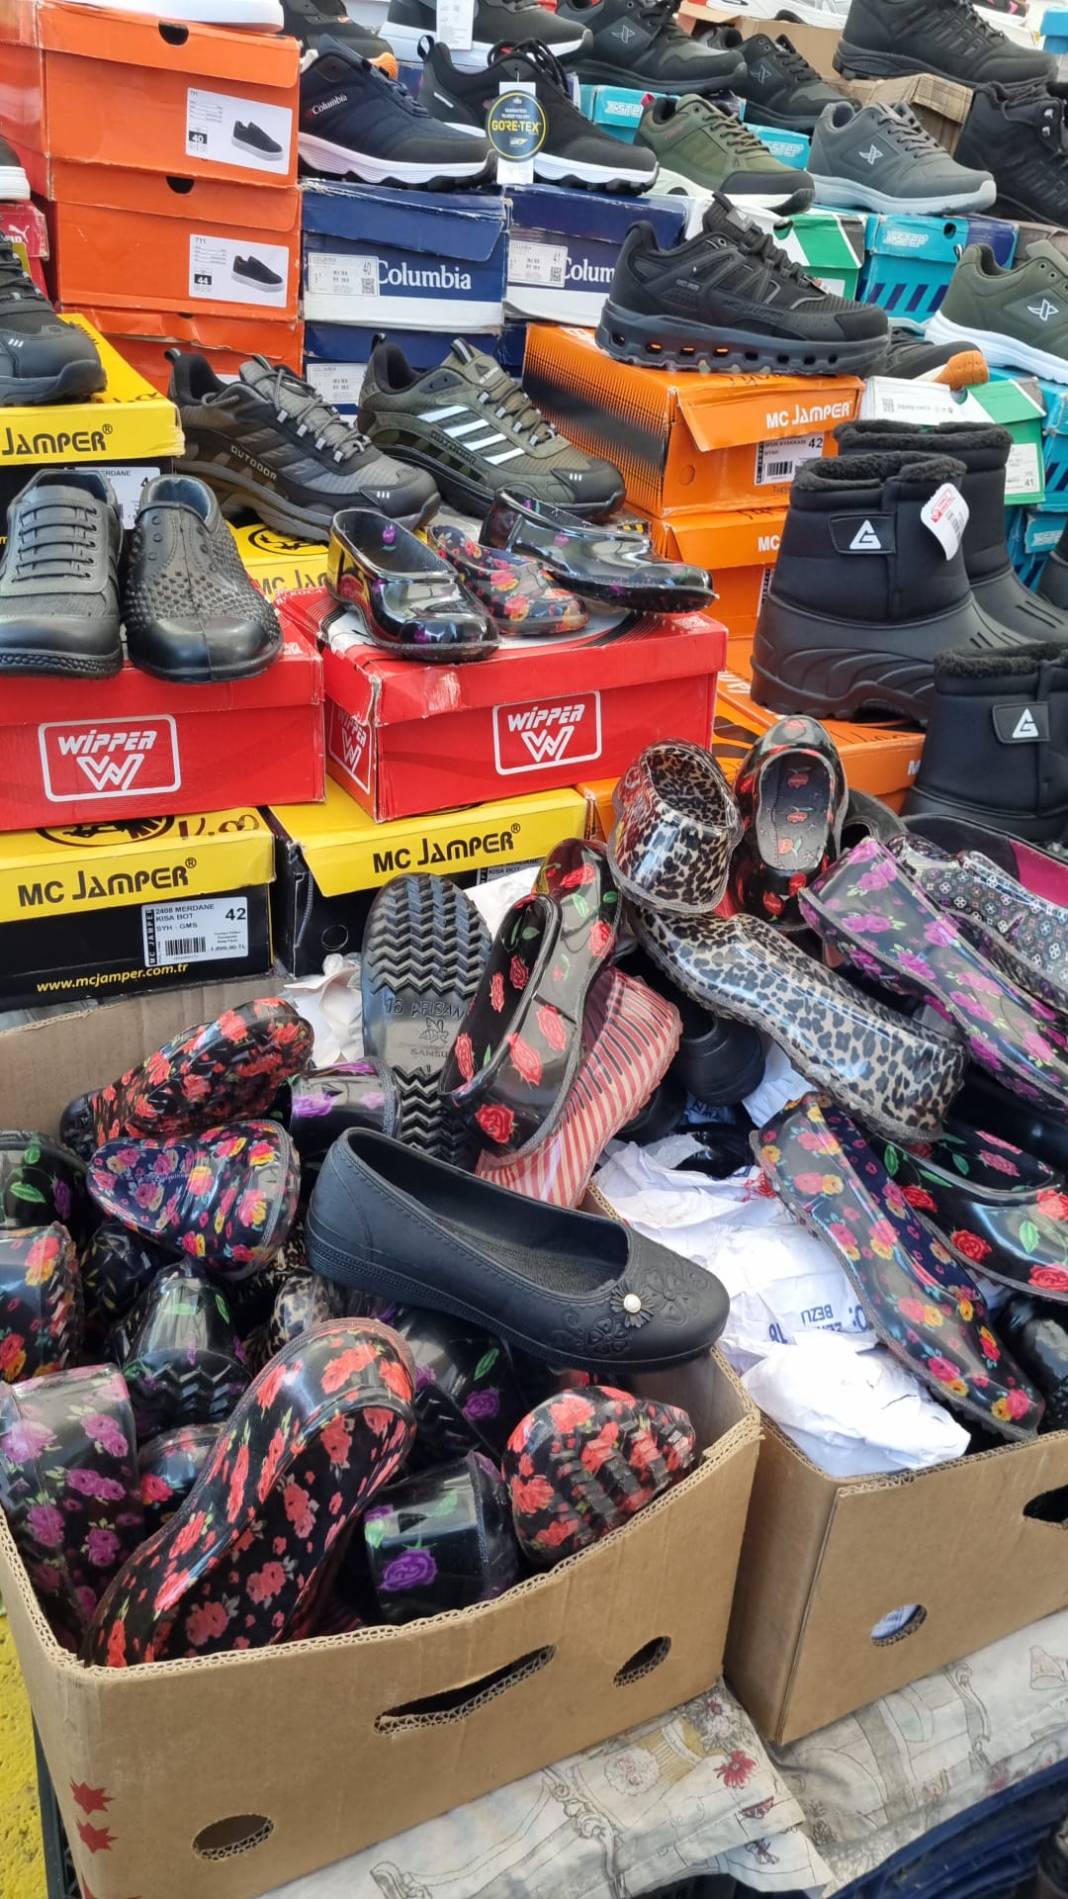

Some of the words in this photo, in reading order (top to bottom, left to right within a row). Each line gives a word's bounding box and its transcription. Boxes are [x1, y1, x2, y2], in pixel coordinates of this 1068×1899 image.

[377, 260, 472, 290] Columbia
[564, 256, 616, 283] Colum
[765, 411, 790, 429] MC
[808, 437, 824, 449] 42
[231, 444, 278, 481] OUTDOOR
[758, 534, 780, 553] MC
[373, 848, 411, 873] MC
[17, 881, 65, 907] MC
[175, 904, 215, 913] MERDANE
[225, 907, 247, 921] 42
[179, 922, 198, 930] GMS
[36, 962, 189, 993] www.mcjamper.com.tr
